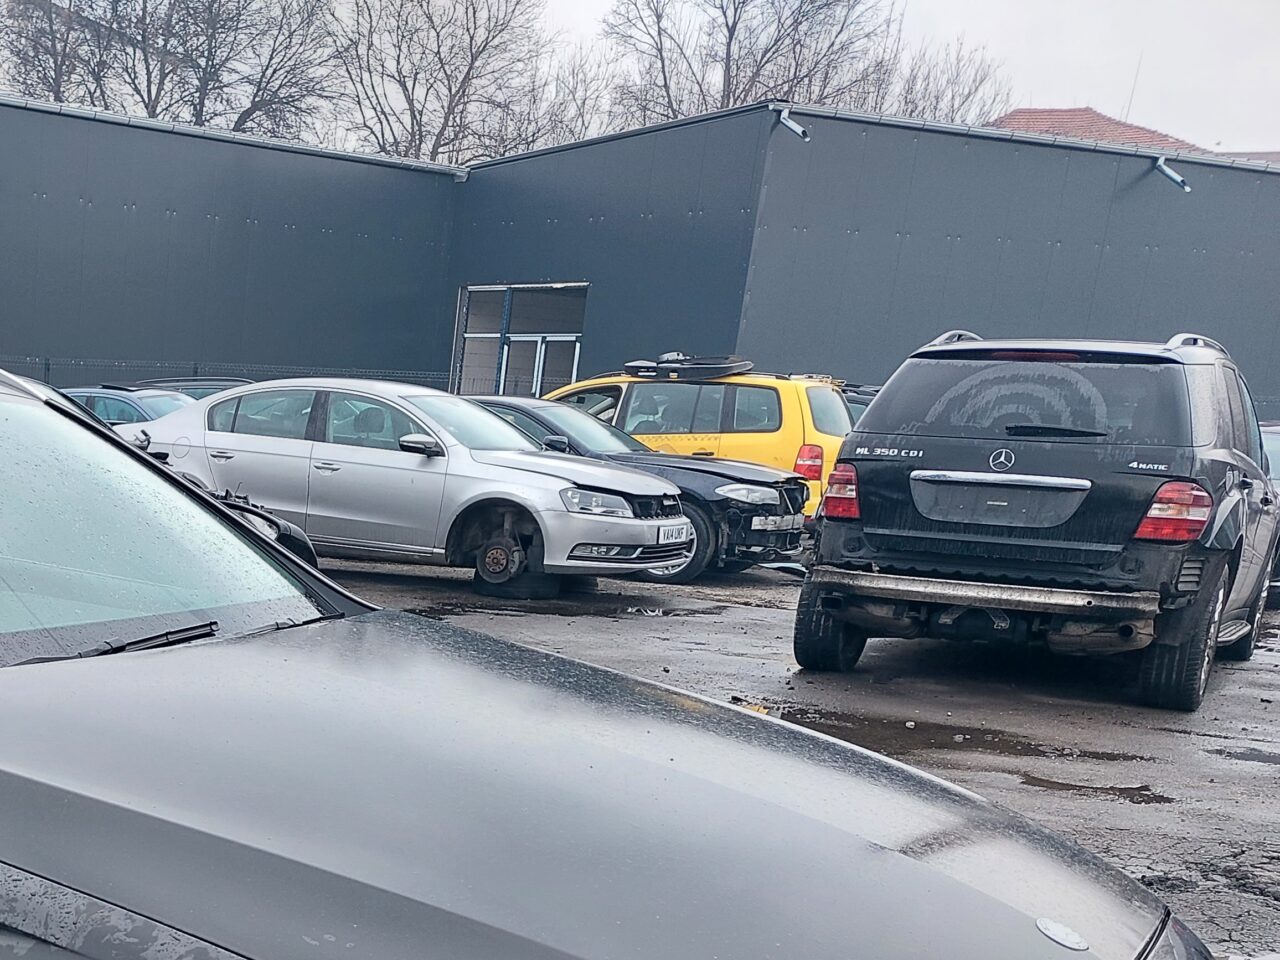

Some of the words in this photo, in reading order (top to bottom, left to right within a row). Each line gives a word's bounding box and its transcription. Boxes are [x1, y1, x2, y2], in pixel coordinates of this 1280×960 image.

[855, 447, 870, 455] ML
[872, 447, 899, 456] 350
[900, 449, 924, 458] CDI
[1128, 461, 1169, 471] 4MATIC
